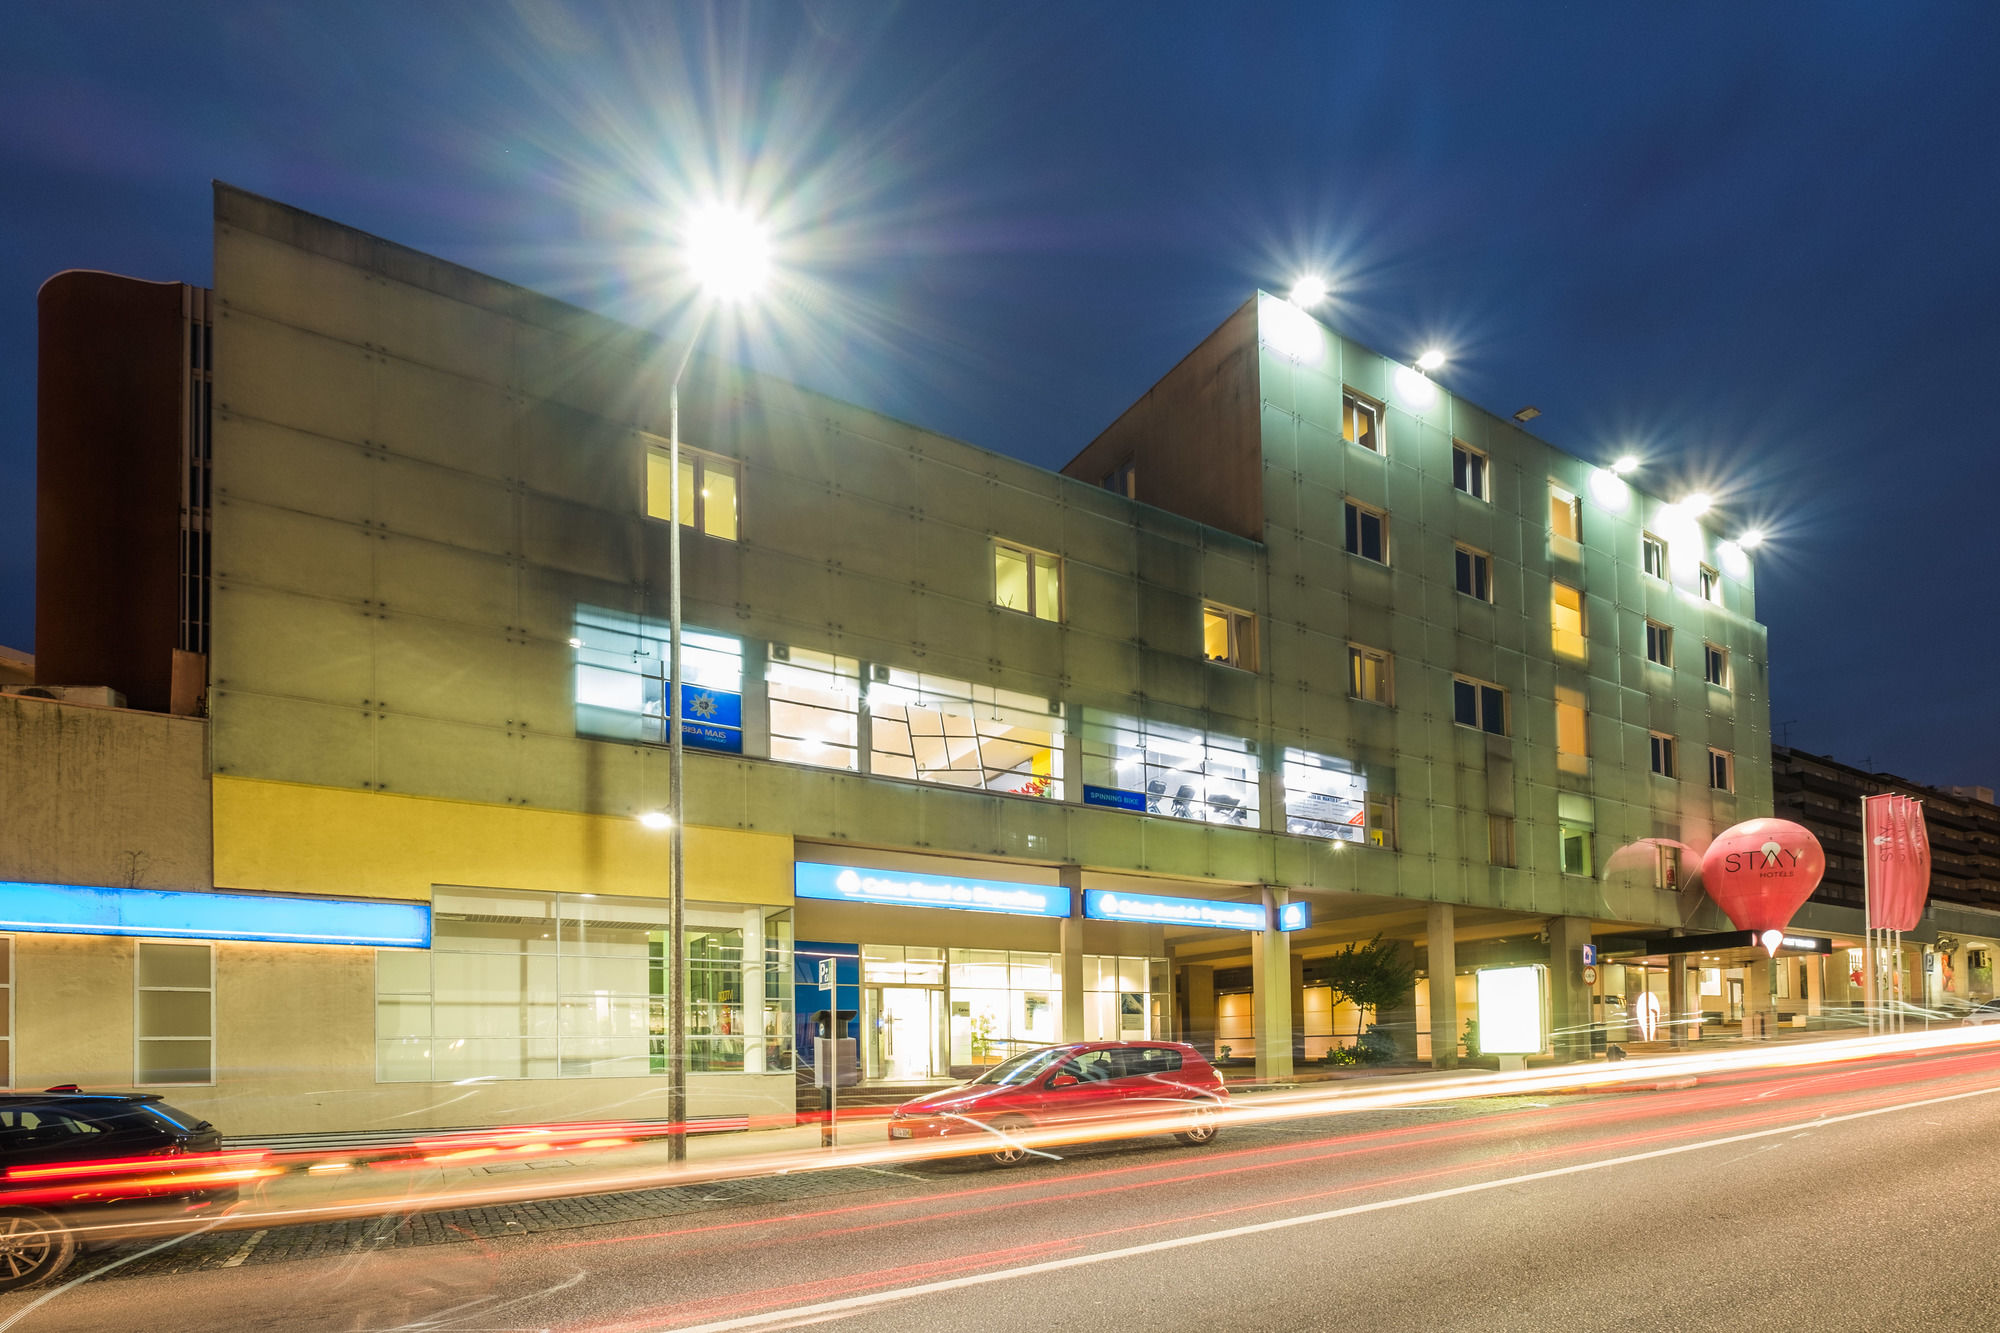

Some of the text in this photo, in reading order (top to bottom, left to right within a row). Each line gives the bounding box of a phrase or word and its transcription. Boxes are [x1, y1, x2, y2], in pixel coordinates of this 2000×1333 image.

[704, 729, 727, 739] MAIS
[1090, 792, 1139, 805] SPINNING BIKE
[1725, 848, 1802, 873] STAY
[1759, 870, 1794, 878] HOTELS
